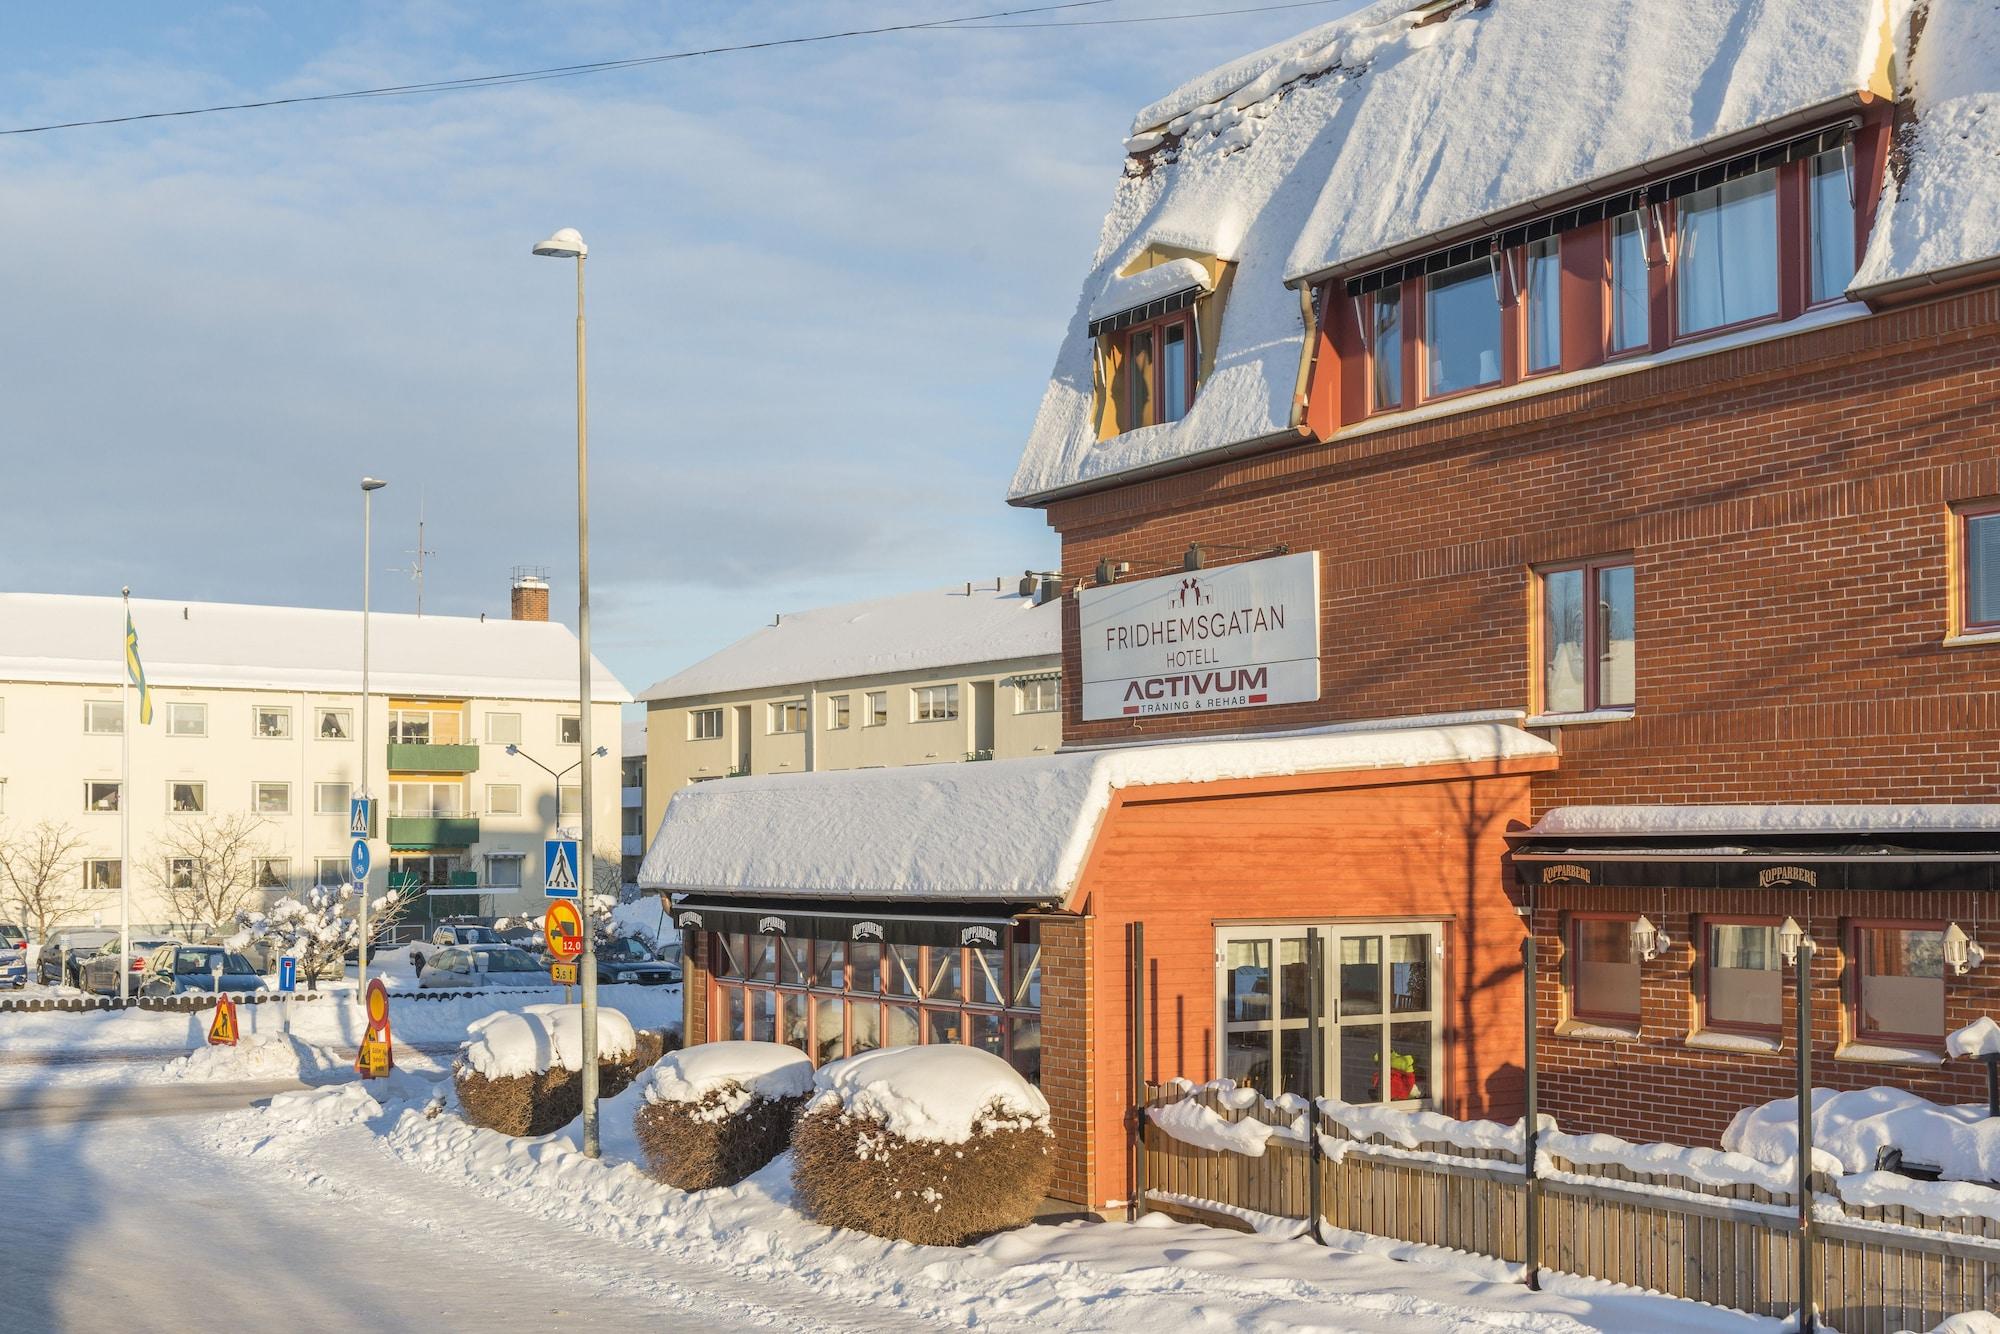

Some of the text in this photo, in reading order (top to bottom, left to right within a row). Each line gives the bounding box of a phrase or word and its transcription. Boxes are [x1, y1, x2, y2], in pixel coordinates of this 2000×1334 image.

[1107, 604, 1284, 651] FRIDHEMSGATAN
[1167, 647, 1219, 668] HOTELL
[1124, 667, 1267, 701] ACTIVUM
[1196, 699, 1202, 708] &
[1208, 695, 1246, 708] REHAB
[1543, 864, 1591, 883] KOPPARBERG
[1759, 866, 1817, 888] KOPPARBERG
